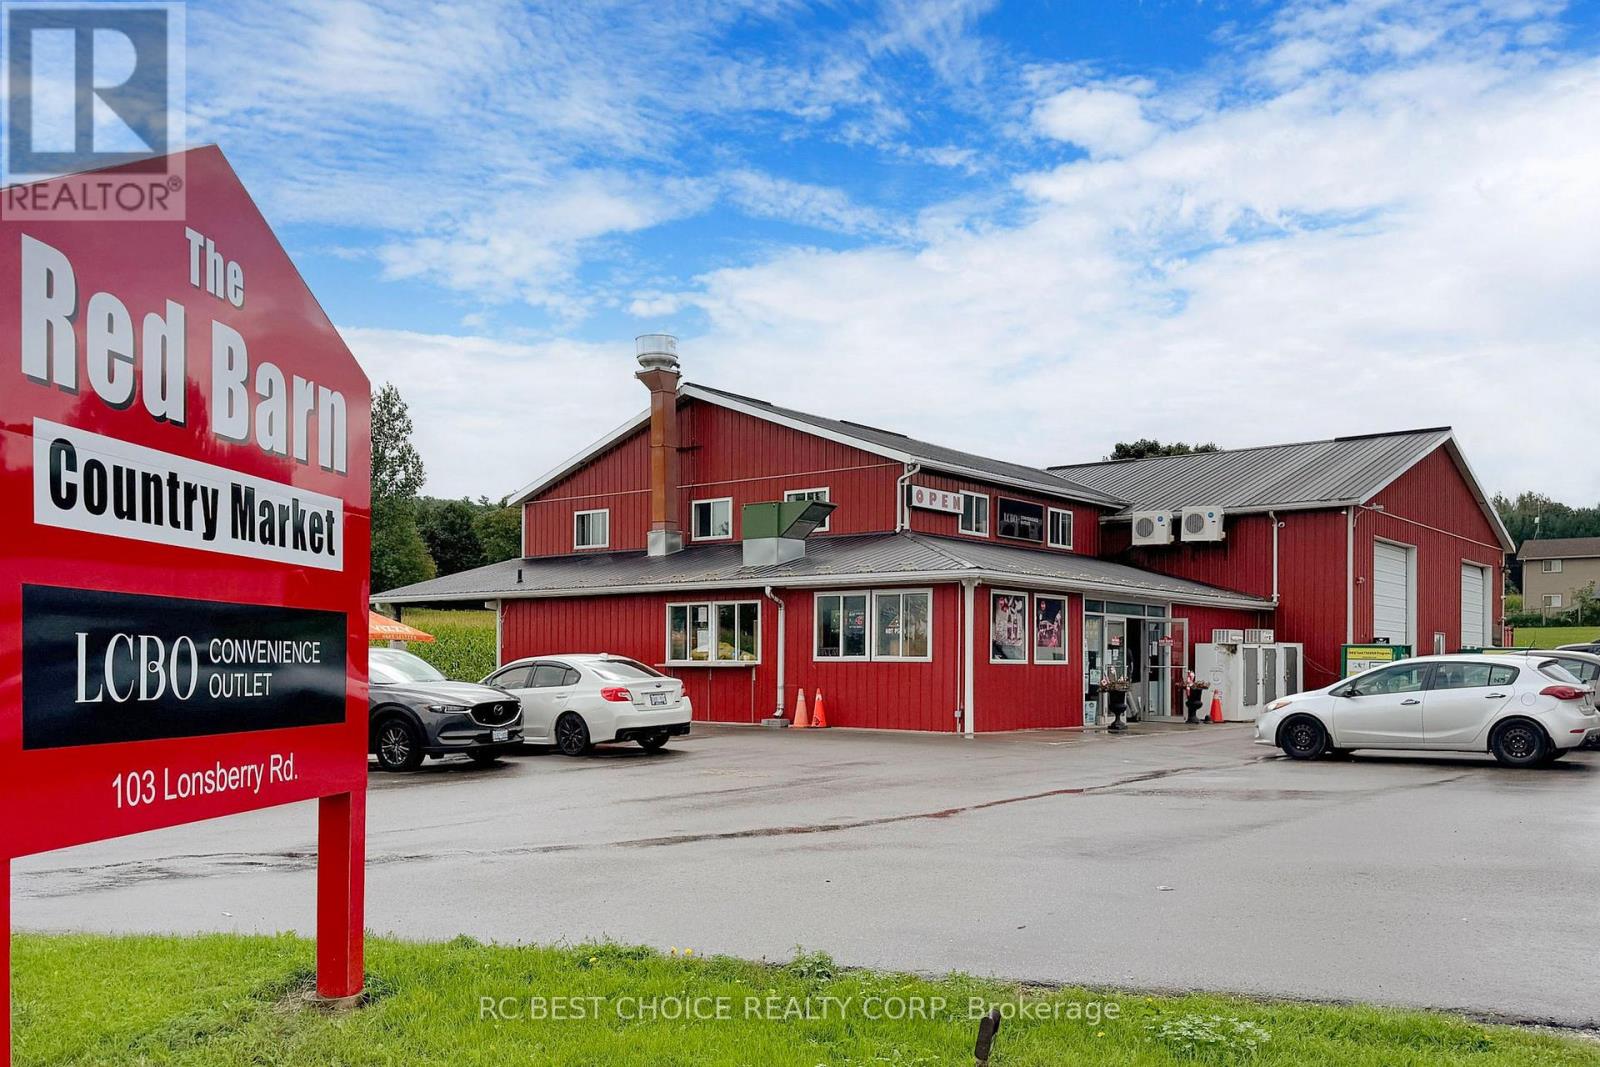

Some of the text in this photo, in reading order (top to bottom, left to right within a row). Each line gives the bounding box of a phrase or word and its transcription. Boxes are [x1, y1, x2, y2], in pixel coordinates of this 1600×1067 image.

[185, 226, 245, 309] The
[21, 232, 349, 476] Red Barn
[49, 438, 336, 556] Country Market
[916, 489, 961, 510] OPEN
[74, 632, 199, 703] LCBO
[209, 638, 321, 664] CONVENIENCE
[209, 673, 272, 698] OUTLET
[112, 753, 298, 808] 103 Lonsberry Rd.
